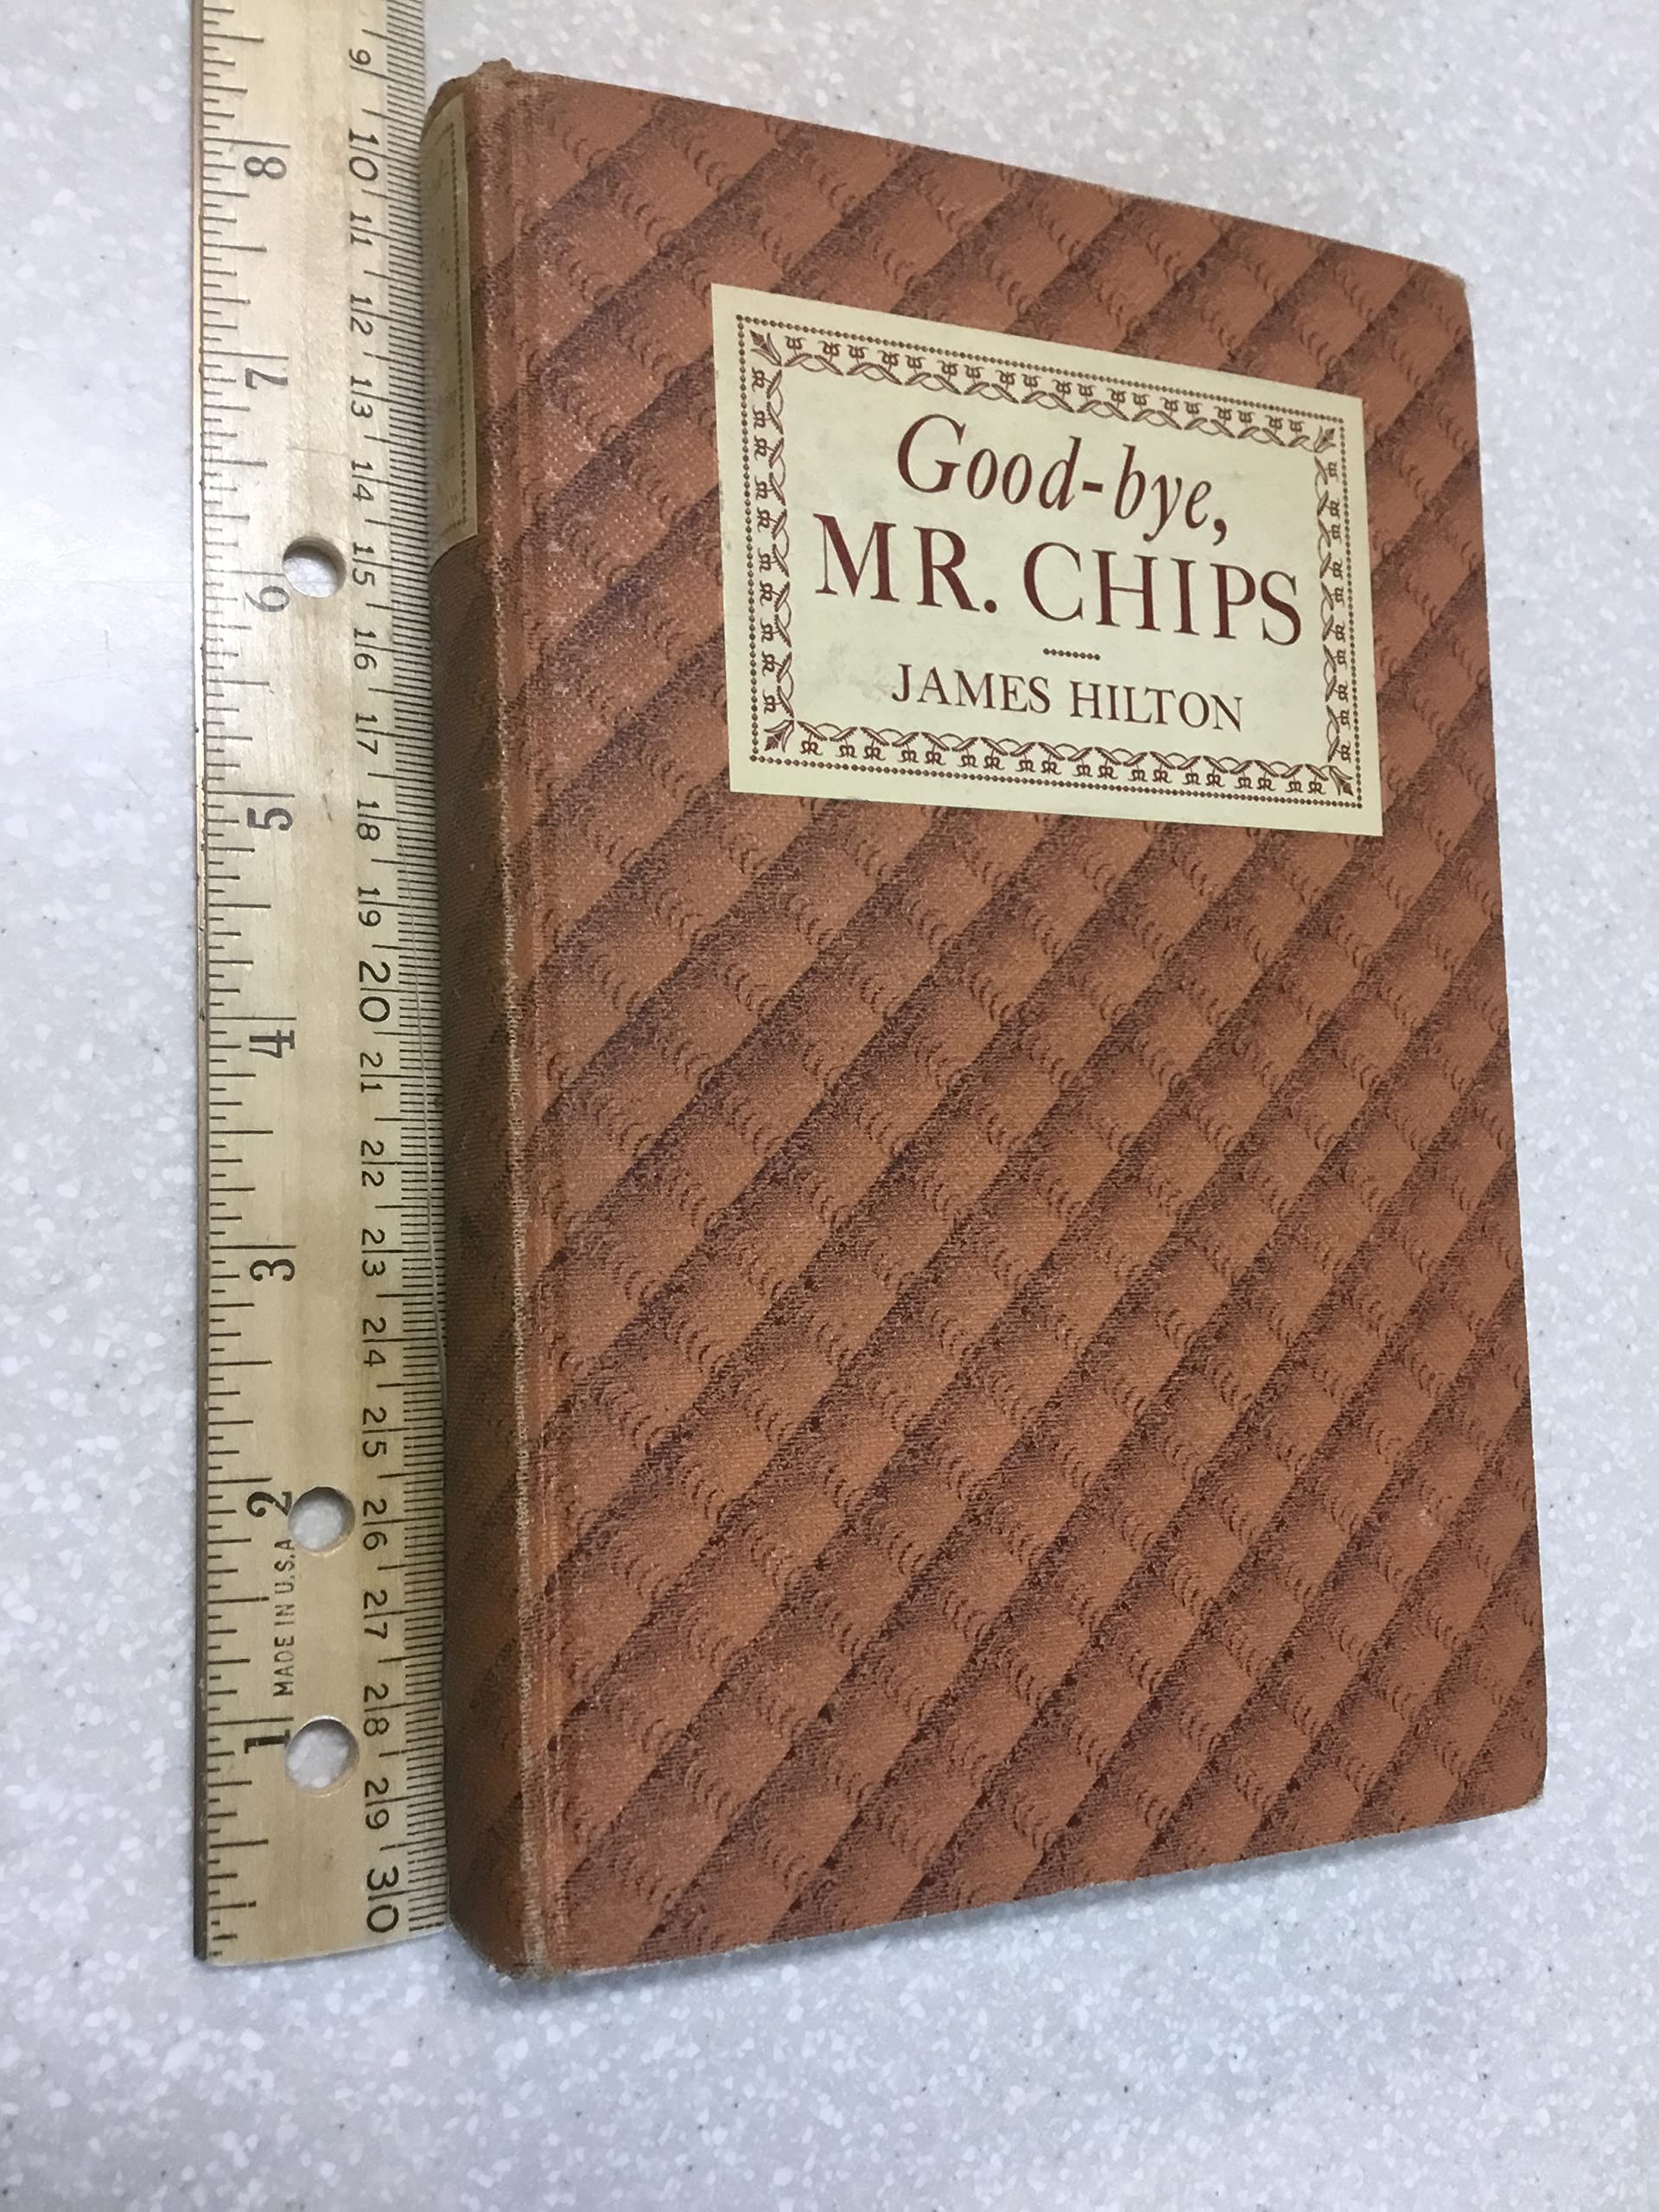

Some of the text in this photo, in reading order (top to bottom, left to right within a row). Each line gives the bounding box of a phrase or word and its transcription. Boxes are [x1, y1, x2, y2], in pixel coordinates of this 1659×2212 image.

[349, 48, 372, 66] 9
[244, 156, 287, 180] 8
[349, 128, 378, 181] 10
[349, 211, 372, 246] 11
[349, 294, 374, 336] 12
[245, 367, 289, 391] 7
[350, 374, 374, 419] 13
[351, 460, 374, 502] 14
[896, 413, 1229, 546] Good-bye,
[353, 543, 376, 587] 15
[812, 512, 1303, 647] MR. CHIPS
[245, 585, 290, 613] 6
[353, 627, 378, 671] 16
[892, 662, 1243, 733] JAMES HILTON
[355, 712, 378, 755] 17
[247, 807, 293, 831] 5
[357, 798, 381, 842] 18
[358, 886, 382, 927] 19
[359, 960, 391, 1023] 20
[249, 1029, 296, 1058] 4
[359, 1052, 384, 1094] 21
[360, 1140, 385, 1187] 22
[250, 1258, 296, 1282] 3
[361, 1229, 385, 1277] 23
[362, 1318, 387, 1368] 24
[363, 1407, 387, 1458] 25
[246, 1491, 292, 1518] 2
[363, 1498, 388, 1551] 26
[274, 1603, 295, 1626] IN
[364, 1589, 388, 1639] 27
[273, 1636, 295, 1697] MADE
[364, 1683, 390, 1737] 28
[245, 1729, 290, 1754] 1
[365, 1777, 390, 1830] 29
[366, 1866, 399, 1933] 30
